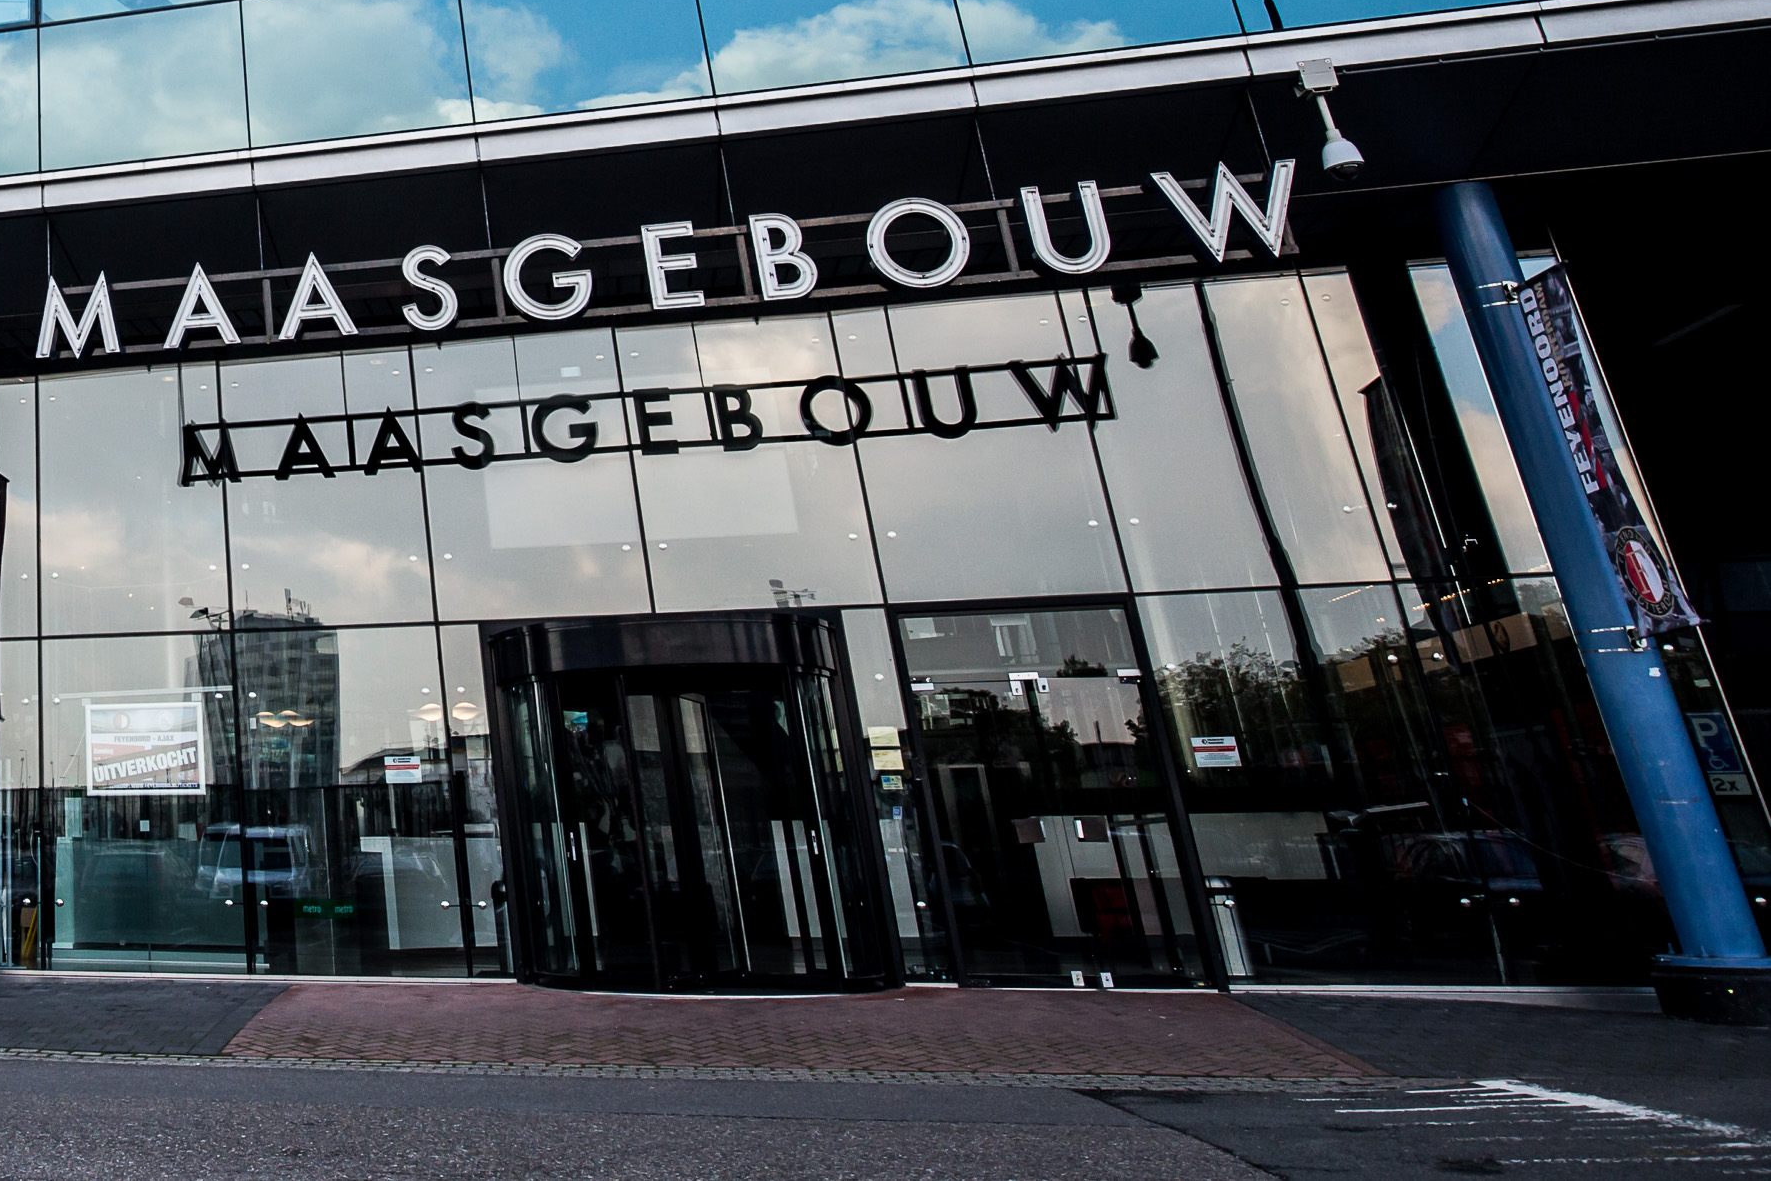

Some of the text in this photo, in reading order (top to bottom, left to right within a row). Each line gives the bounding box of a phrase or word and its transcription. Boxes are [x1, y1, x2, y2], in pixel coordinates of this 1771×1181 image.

[35, 158, 1296, 360] MAASGEBOUW
[1533, 281, 1572, 388] ROTTERDAM
[181, 352, 1112, 487] MAASGEBOUW
[1519, 287, 1600, 495] FEYENOORD
[93, 747, 197, 783] UITVERKOCHT
[157, 734, 175, 742] AJAX
[1691, 718, 1719, 748] P
[1712, 778, 1740, 792] 2x
